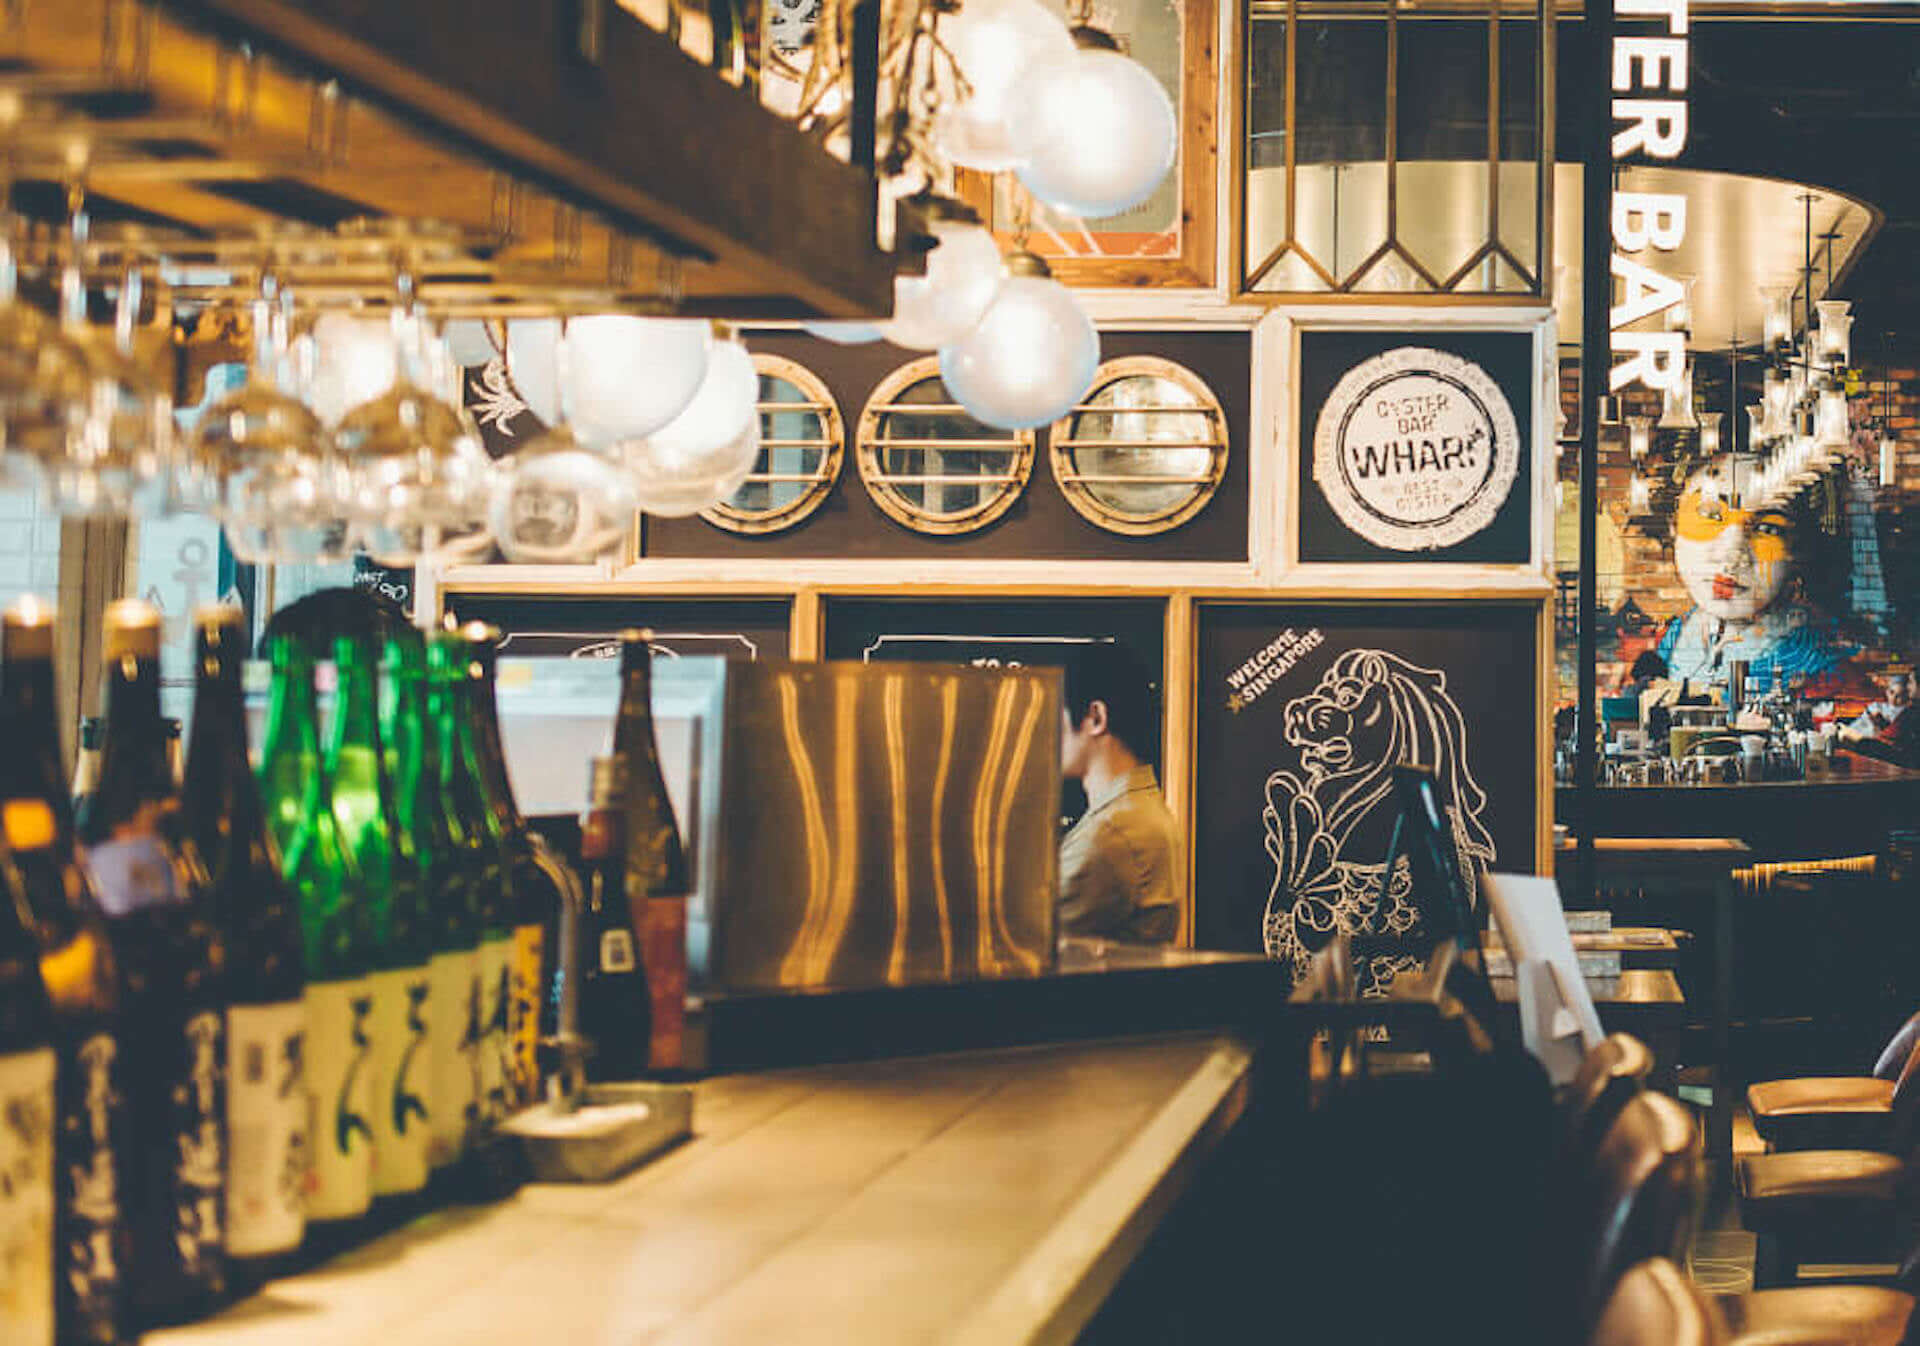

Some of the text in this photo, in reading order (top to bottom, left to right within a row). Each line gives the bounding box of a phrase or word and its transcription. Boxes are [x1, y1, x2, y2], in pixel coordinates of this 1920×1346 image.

[1609, 193, 1687, 394] BAR
[1397, 415, 1434, 435] BAR
[1226, 627, 1299, 690] WELCOME
[1241, 628, 1326, 703] SINGAPORE
